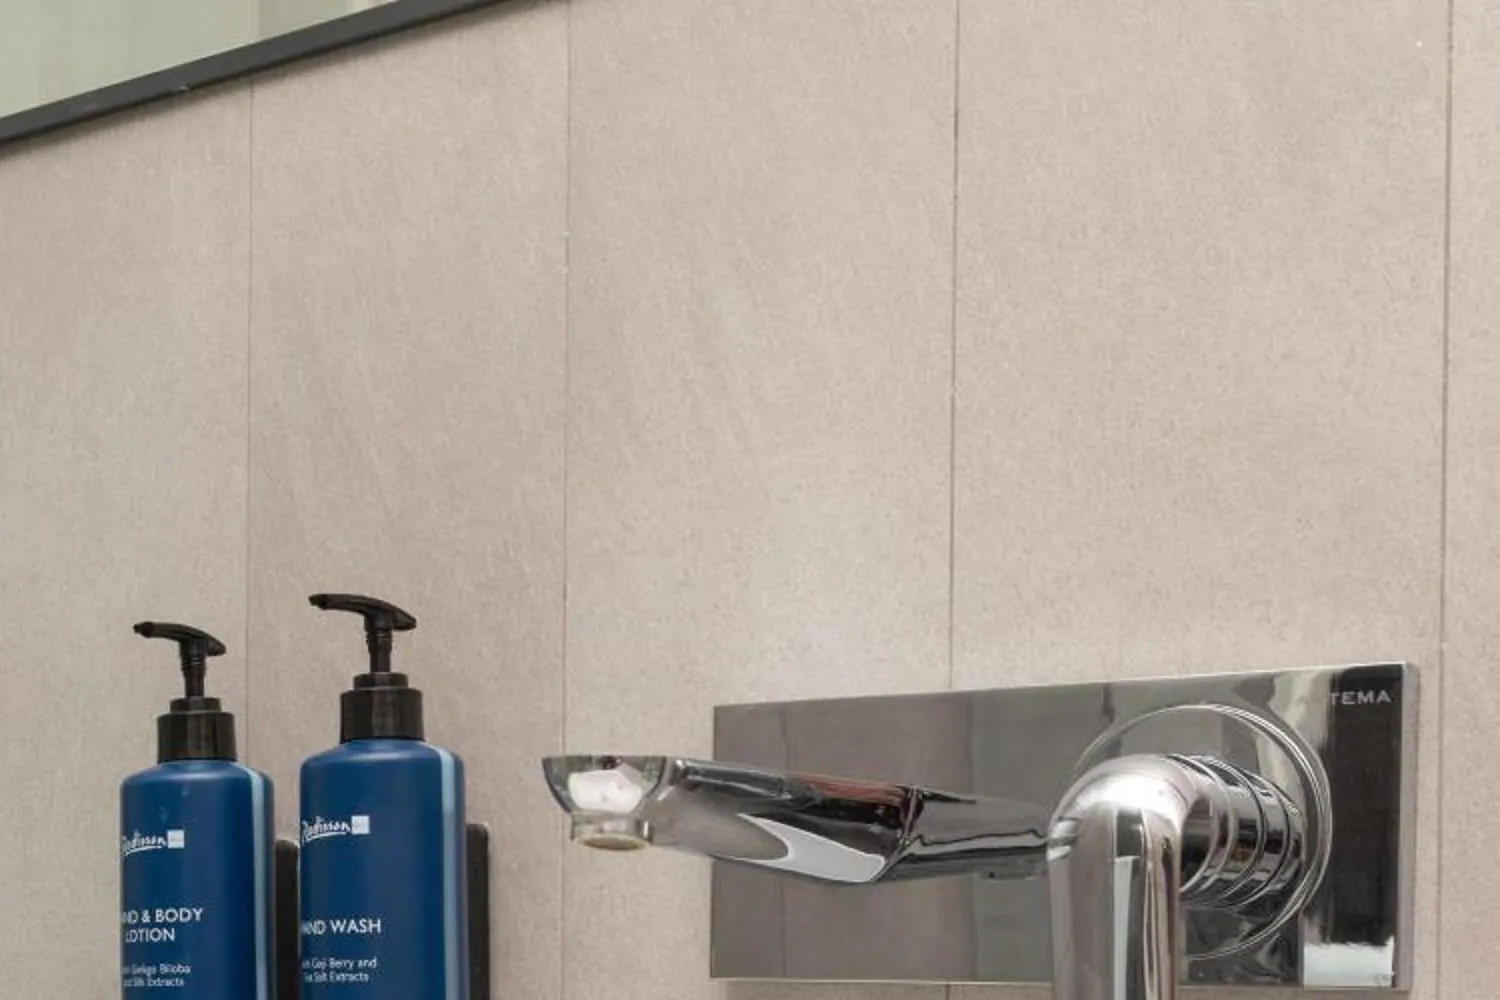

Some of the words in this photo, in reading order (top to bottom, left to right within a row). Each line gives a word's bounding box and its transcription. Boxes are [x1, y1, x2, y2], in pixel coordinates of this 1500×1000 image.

[141, 909, 151, 923] &
[155, 908, 203, 922] BODY
[329, 917, 382, 934] WASH
[125, 927, 176, 942] LOTION
[358, 956, 377, 969] and
[330, 971, 369, 983] Extracts
